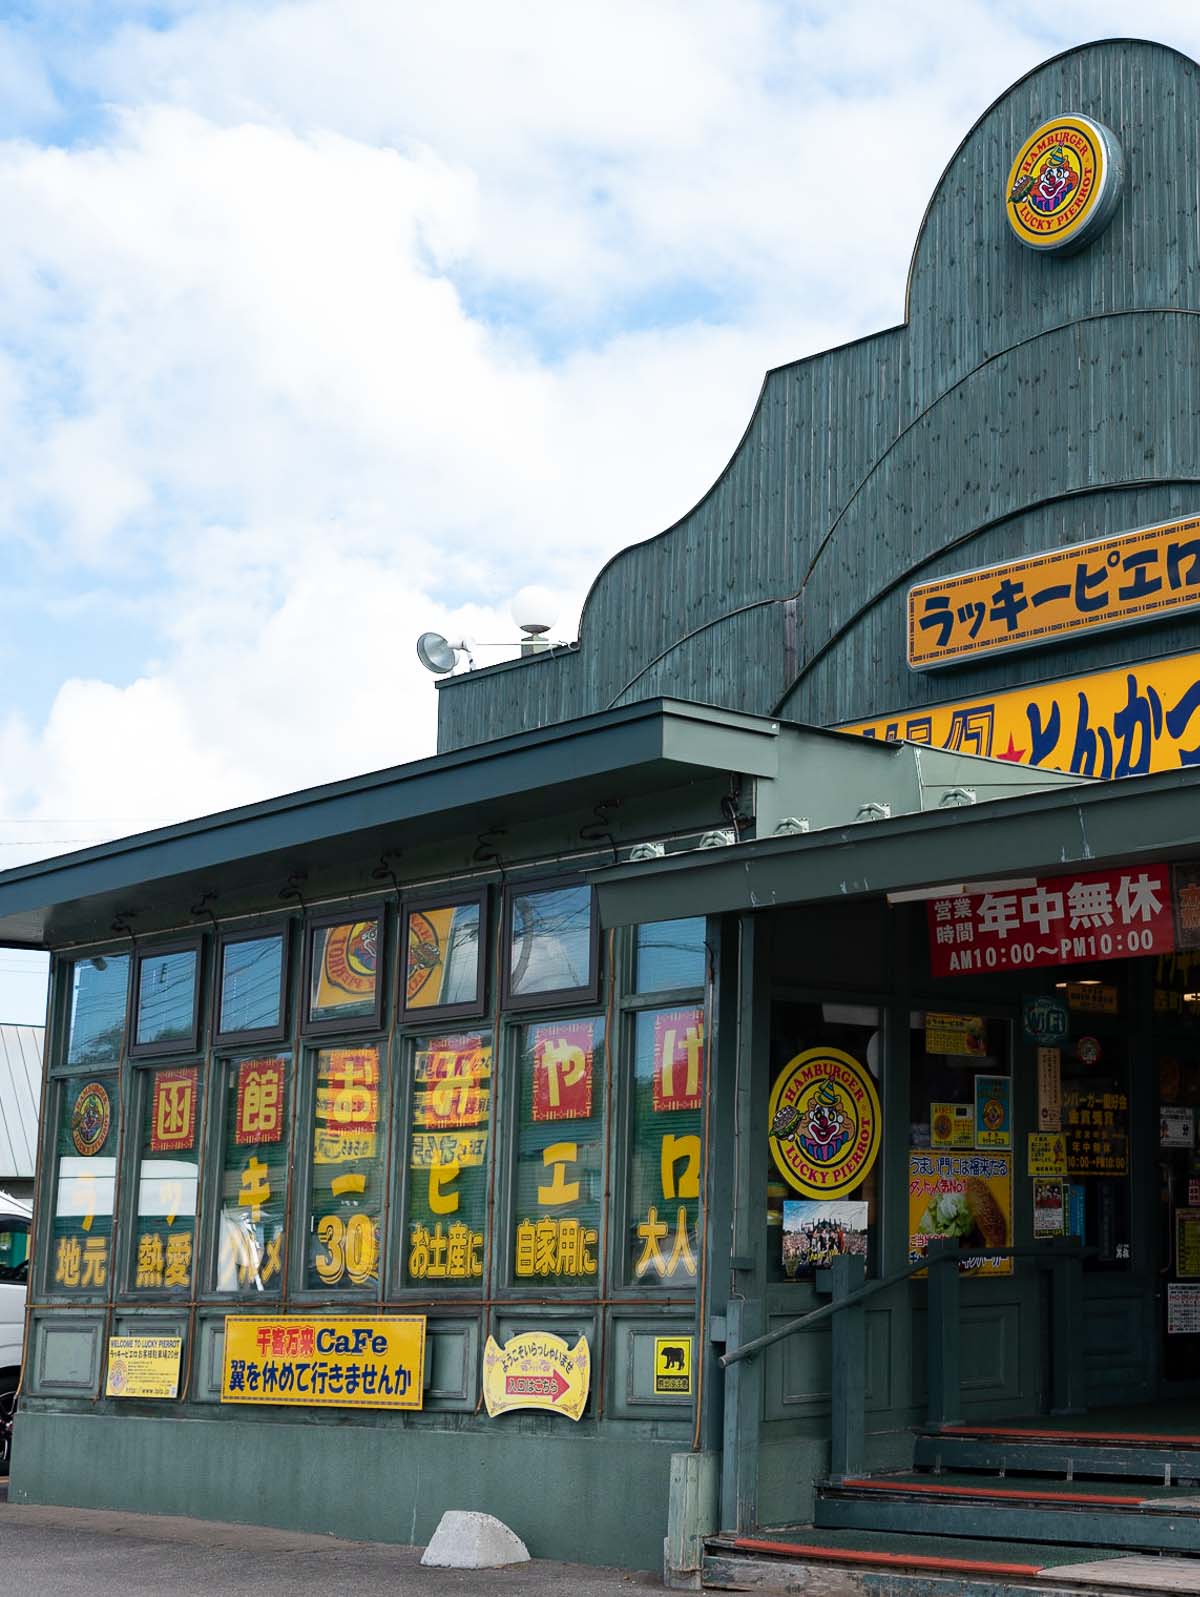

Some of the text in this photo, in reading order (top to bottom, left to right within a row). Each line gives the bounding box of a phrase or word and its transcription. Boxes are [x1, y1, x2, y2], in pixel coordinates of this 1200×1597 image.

[1022, 132, 1088, 173] HAMBURGER
[1020, 168, 1092, 230] LUCKY PIERROT
[934, 897, 972, 921] 営業
[976, 873, 1163, 939] 年中無休
[936, 922, 974, 945] 時間
[785, 1062, 864, 1102] HAMBURGER
[786, 1145, 828, 1184] LUCKY
[832, 1118, 871, 1184] PIERROT
[55, 1233, 107, 1288] 地元
[136, 1231, 192, 1288] 熱愛
[315, 1213, 375, 1285] 30
[409, 1220, 484, 1279] お土産に
[516, 1215, 598, 1277] 自家用に
[256, 1325, 315, 1357] 千客万来
[502, 1341, 574, 1374] ようこそいらっしゃいませ
[229, 1359, 412, 1395] 翼を休めて行きませんか
[507, 1378, 559, 1394] 入口はこちら
